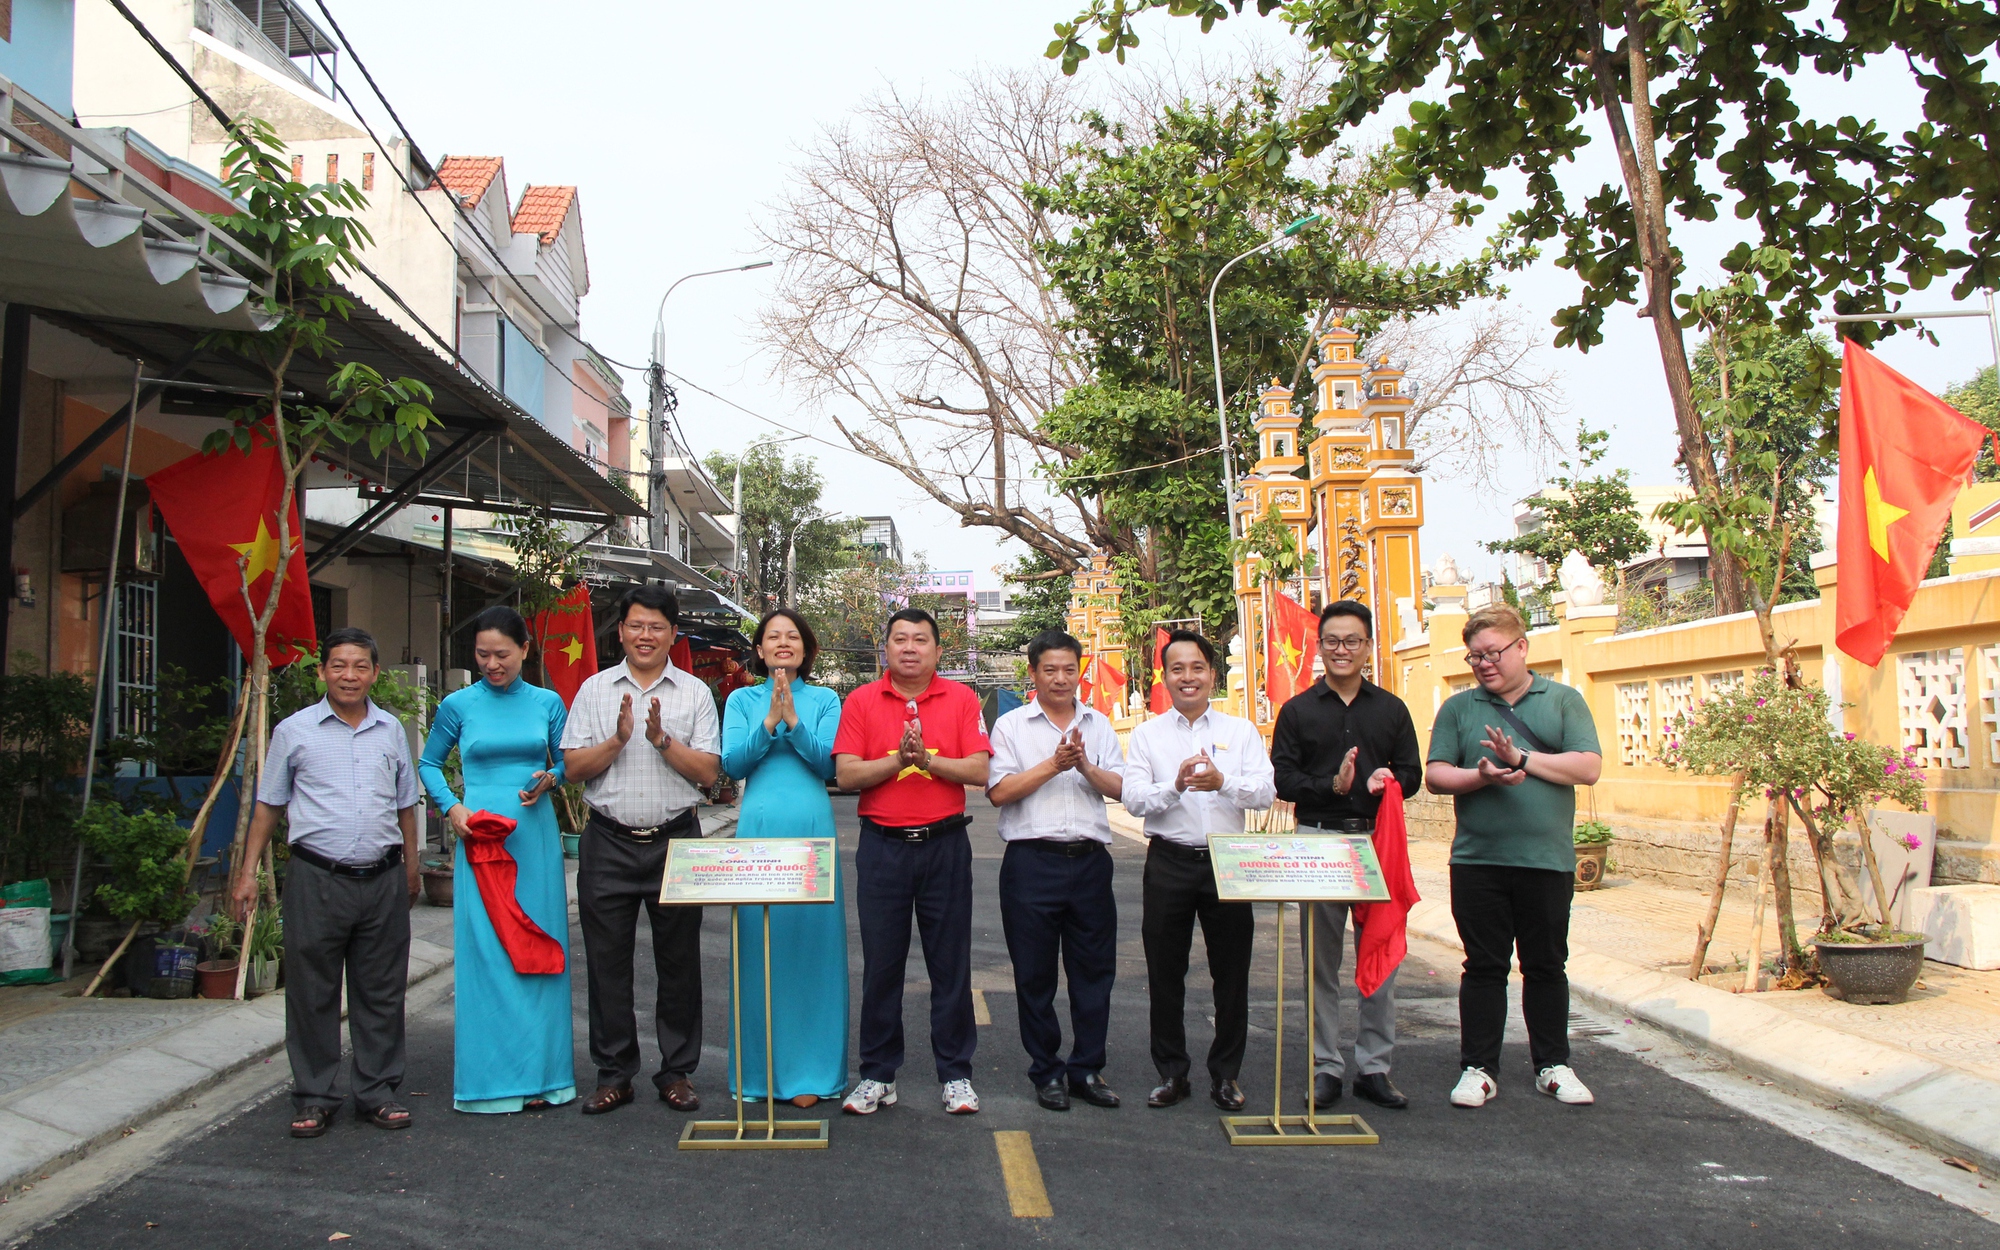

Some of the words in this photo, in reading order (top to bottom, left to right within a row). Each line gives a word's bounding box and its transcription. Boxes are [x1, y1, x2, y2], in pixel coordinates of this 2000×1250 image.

[692, 864, 734, 872] ĐƯỜNG
[737, 864, 755, 872] CỜ
[758, 864, 773, 872] TỔ
[776, 864, 807, 872] QUỐC
[1239, 861, 1280, 869] ĐƯỜNG
[1284, 861, 1300, 869] CỜ
[1303, 861, 1318, 869] TỔ
[1321, 861, 1353, 869] QUỐC
